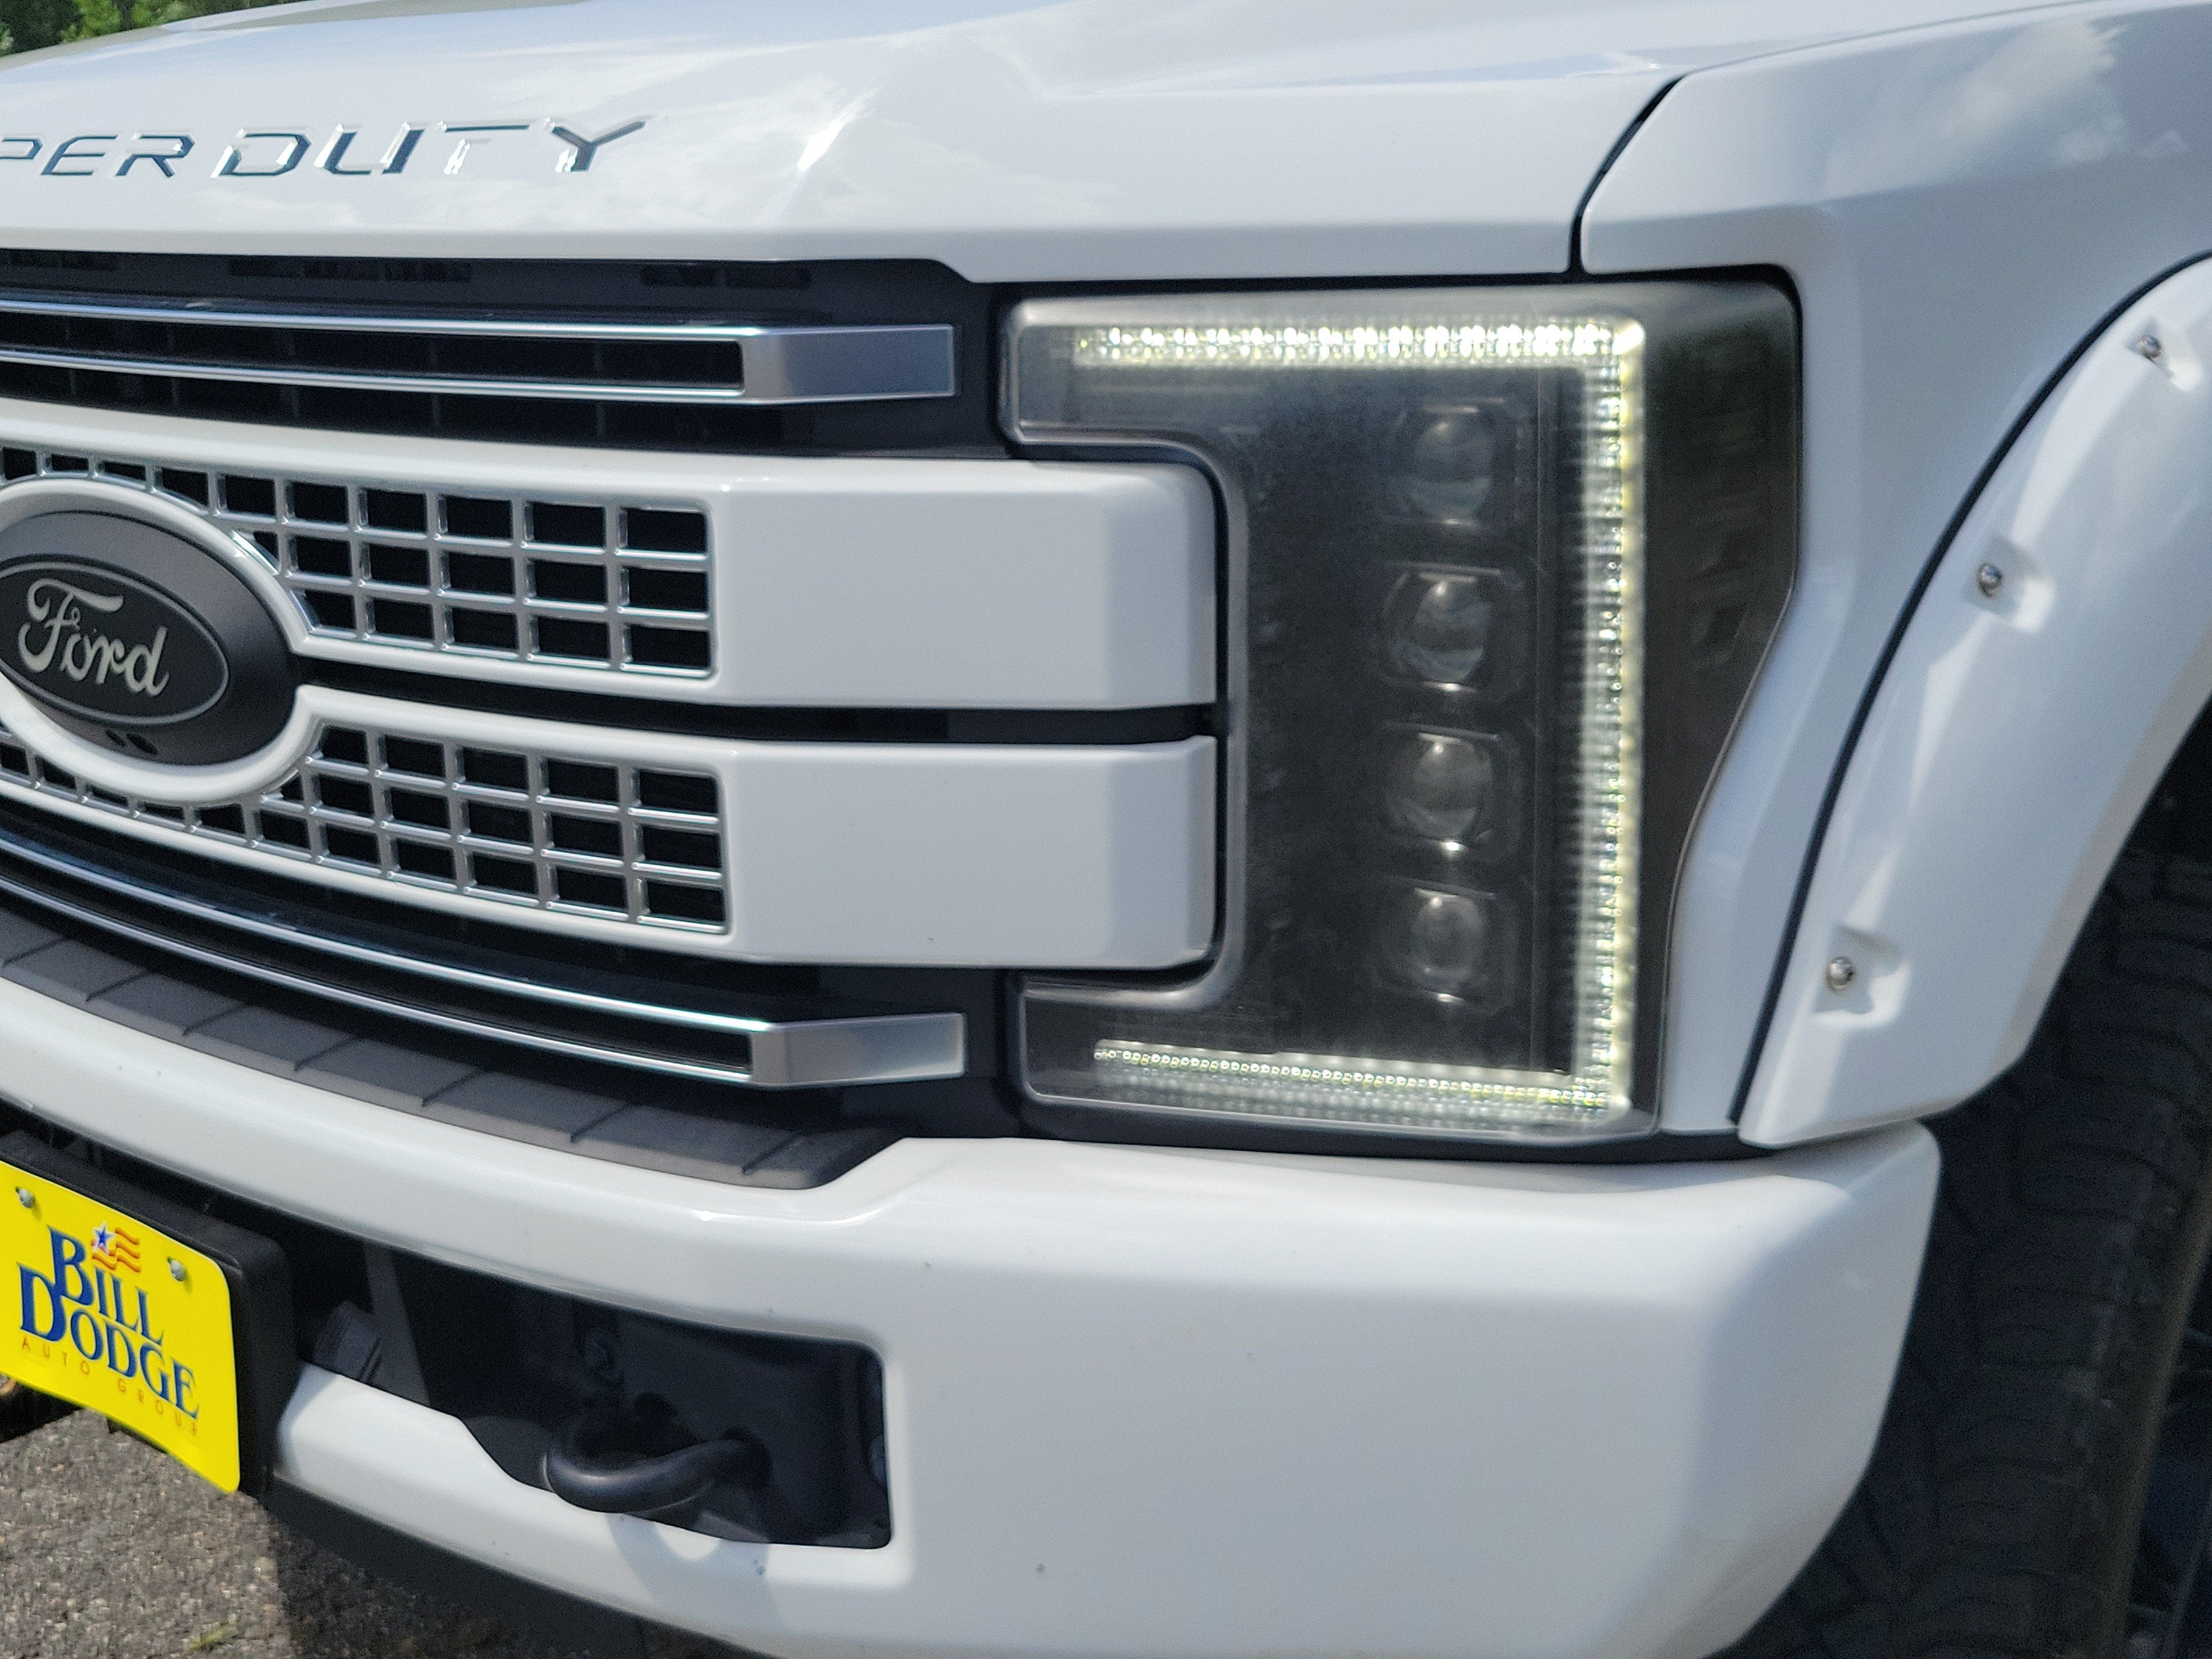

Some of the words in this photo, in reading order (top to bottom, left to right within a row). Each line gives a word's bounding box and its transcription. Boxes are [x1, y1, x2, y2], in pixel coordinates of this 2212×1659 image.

[210, 117, 647, 178] DUTY
[18, 578, 170, 696] Ford
[16, 1262, 199, 1419] DODGE
[48, 1225, 163, 1346] BILL
[22, 1336, 91, 1375] AUTO
